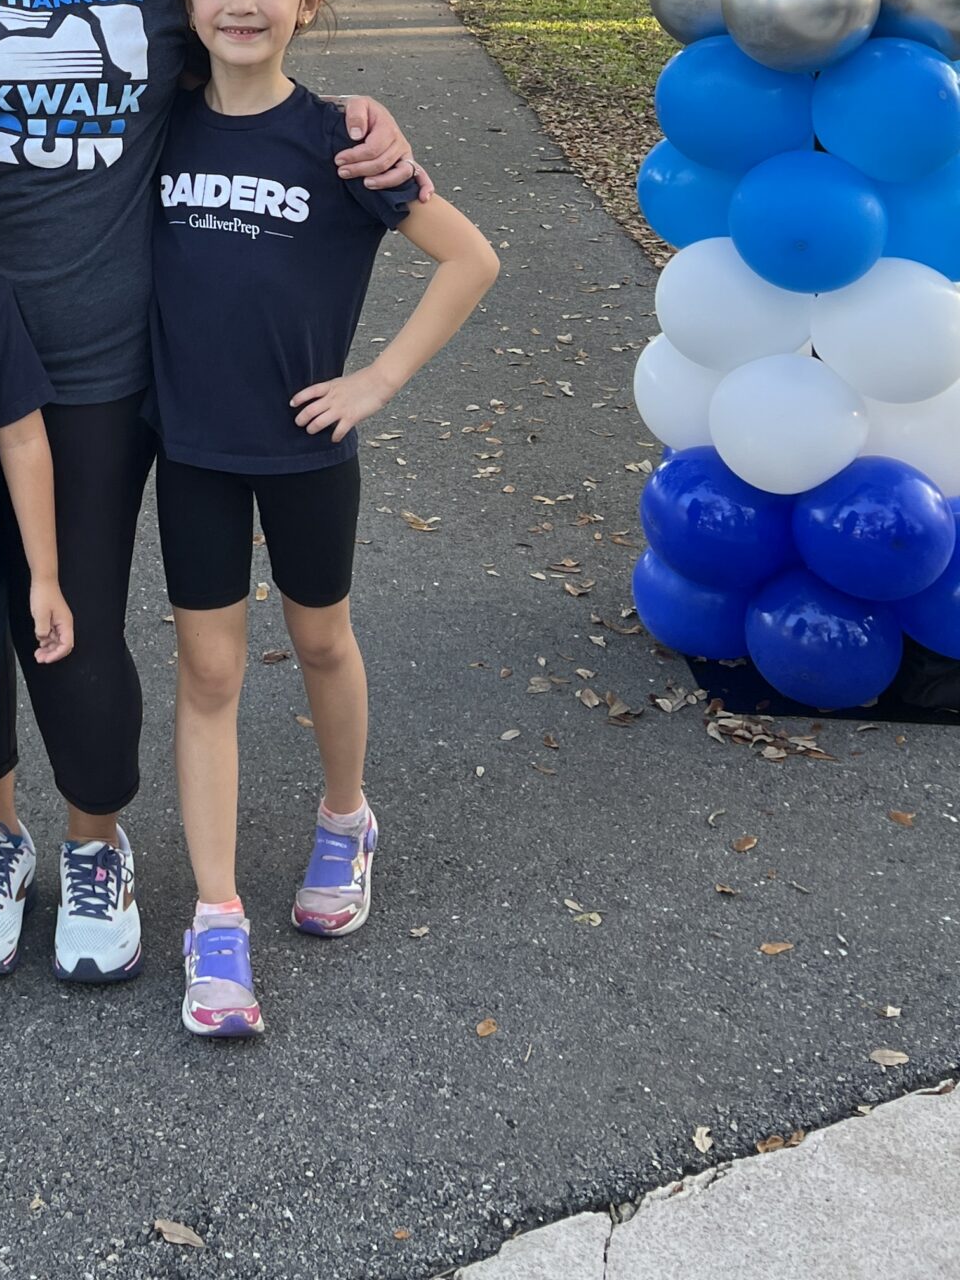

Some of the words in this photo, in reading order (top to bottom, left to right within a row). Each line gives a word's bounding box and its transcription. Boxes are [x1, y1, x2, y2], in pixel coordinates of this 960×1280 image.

[17, 83, 148, 116] WALK
[160, 173, 311, 223] RAIDERS
[189, 214, 260, 239] GulliverPrep
